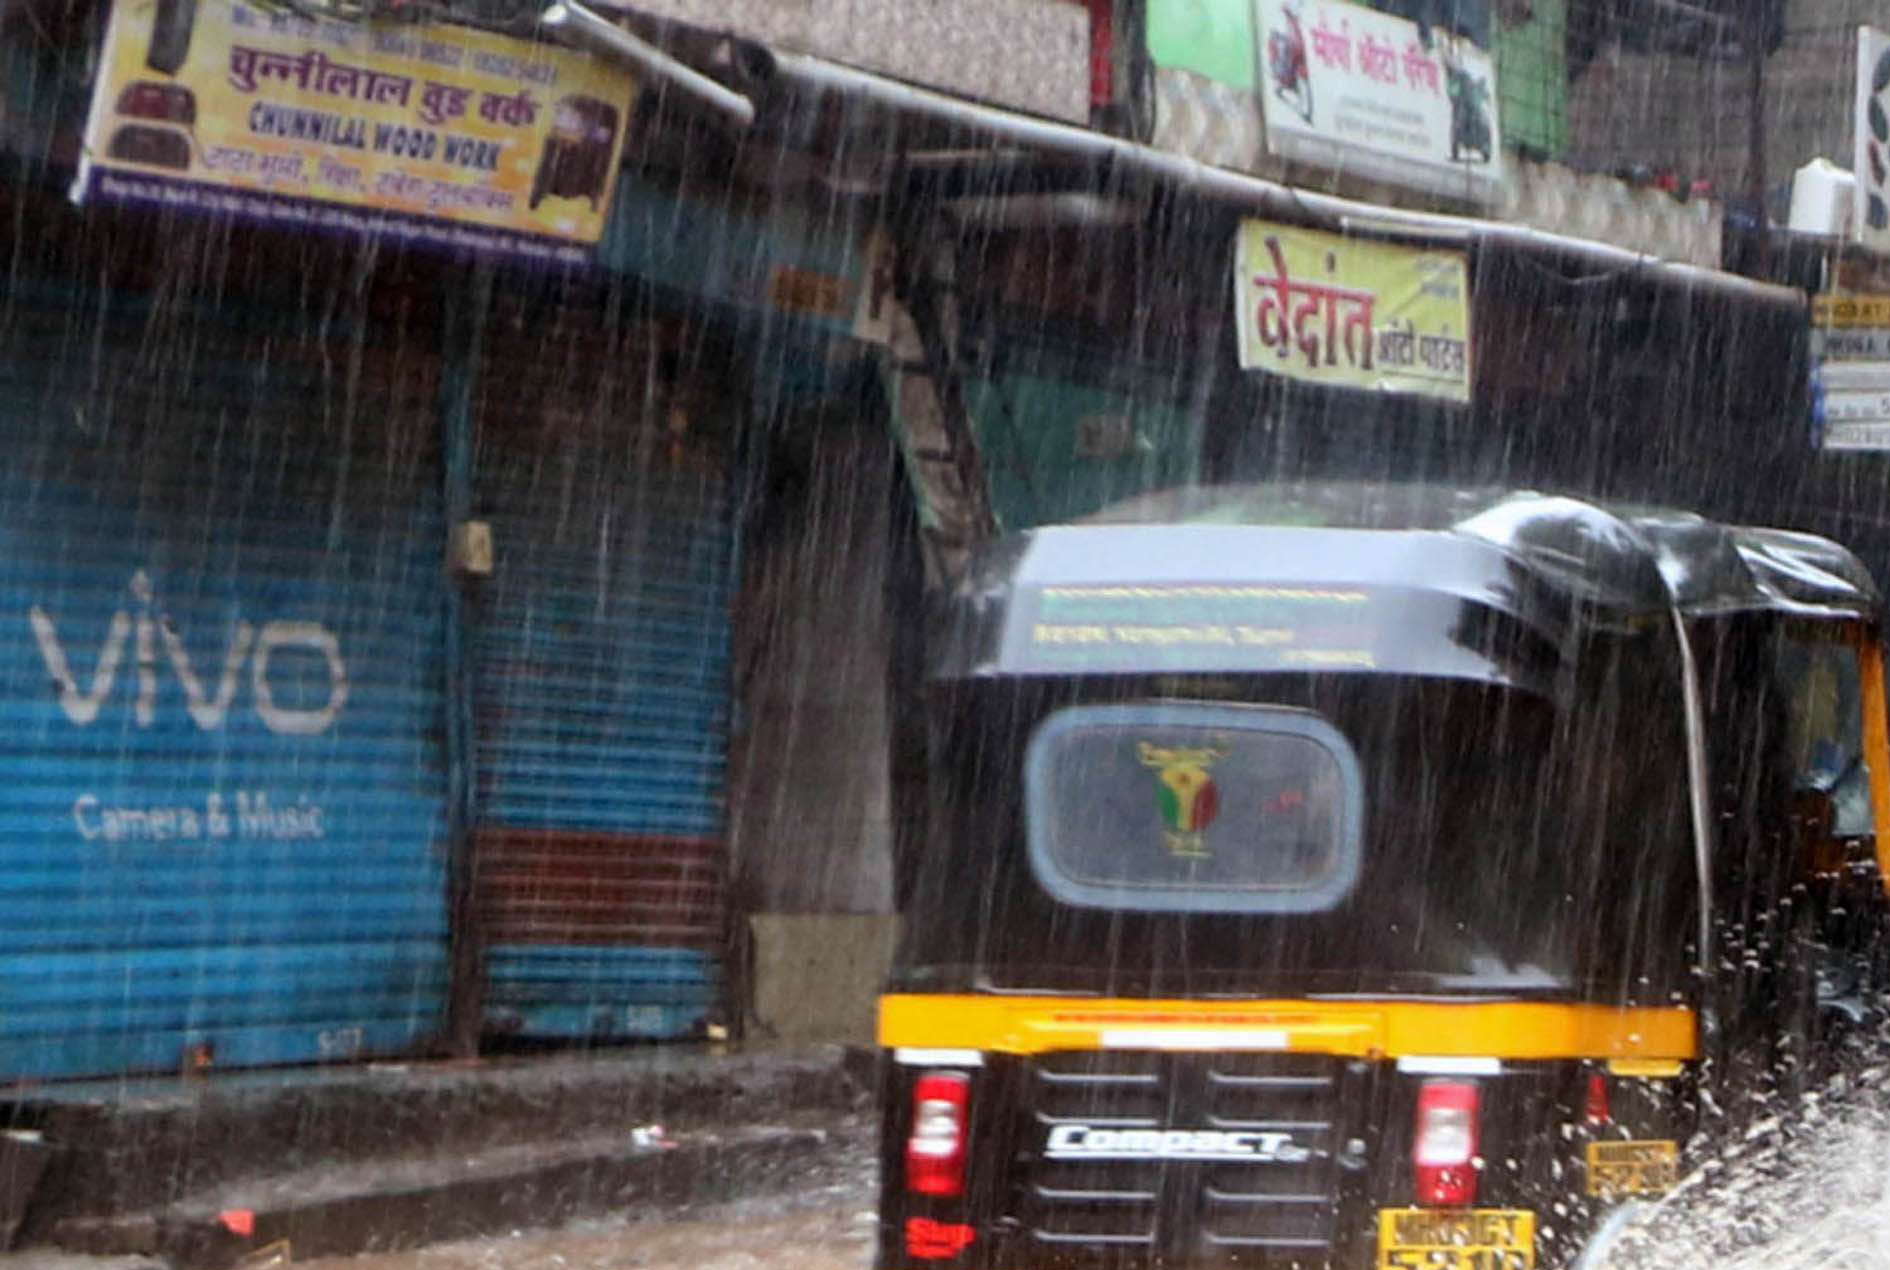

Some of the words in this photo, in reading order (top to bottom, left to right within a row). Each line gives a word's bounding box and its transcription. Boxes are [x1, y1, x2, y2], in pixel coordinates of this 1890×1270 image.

[229, 45, 412, 107] चुन्नीलाल
[417, 80, 475, 125] वुड
[479, 88, 538, 126] वर्क
[249, 101, 365, 149] CHUNNILAL
[374, 122, 437, 161] WOOD
[445, 133, 500, 171] WORK
[1253, 235, 1377, 371] वेदांत
[73, 794, 199, 840] Camera
[236, 790, 326, 840] Music
